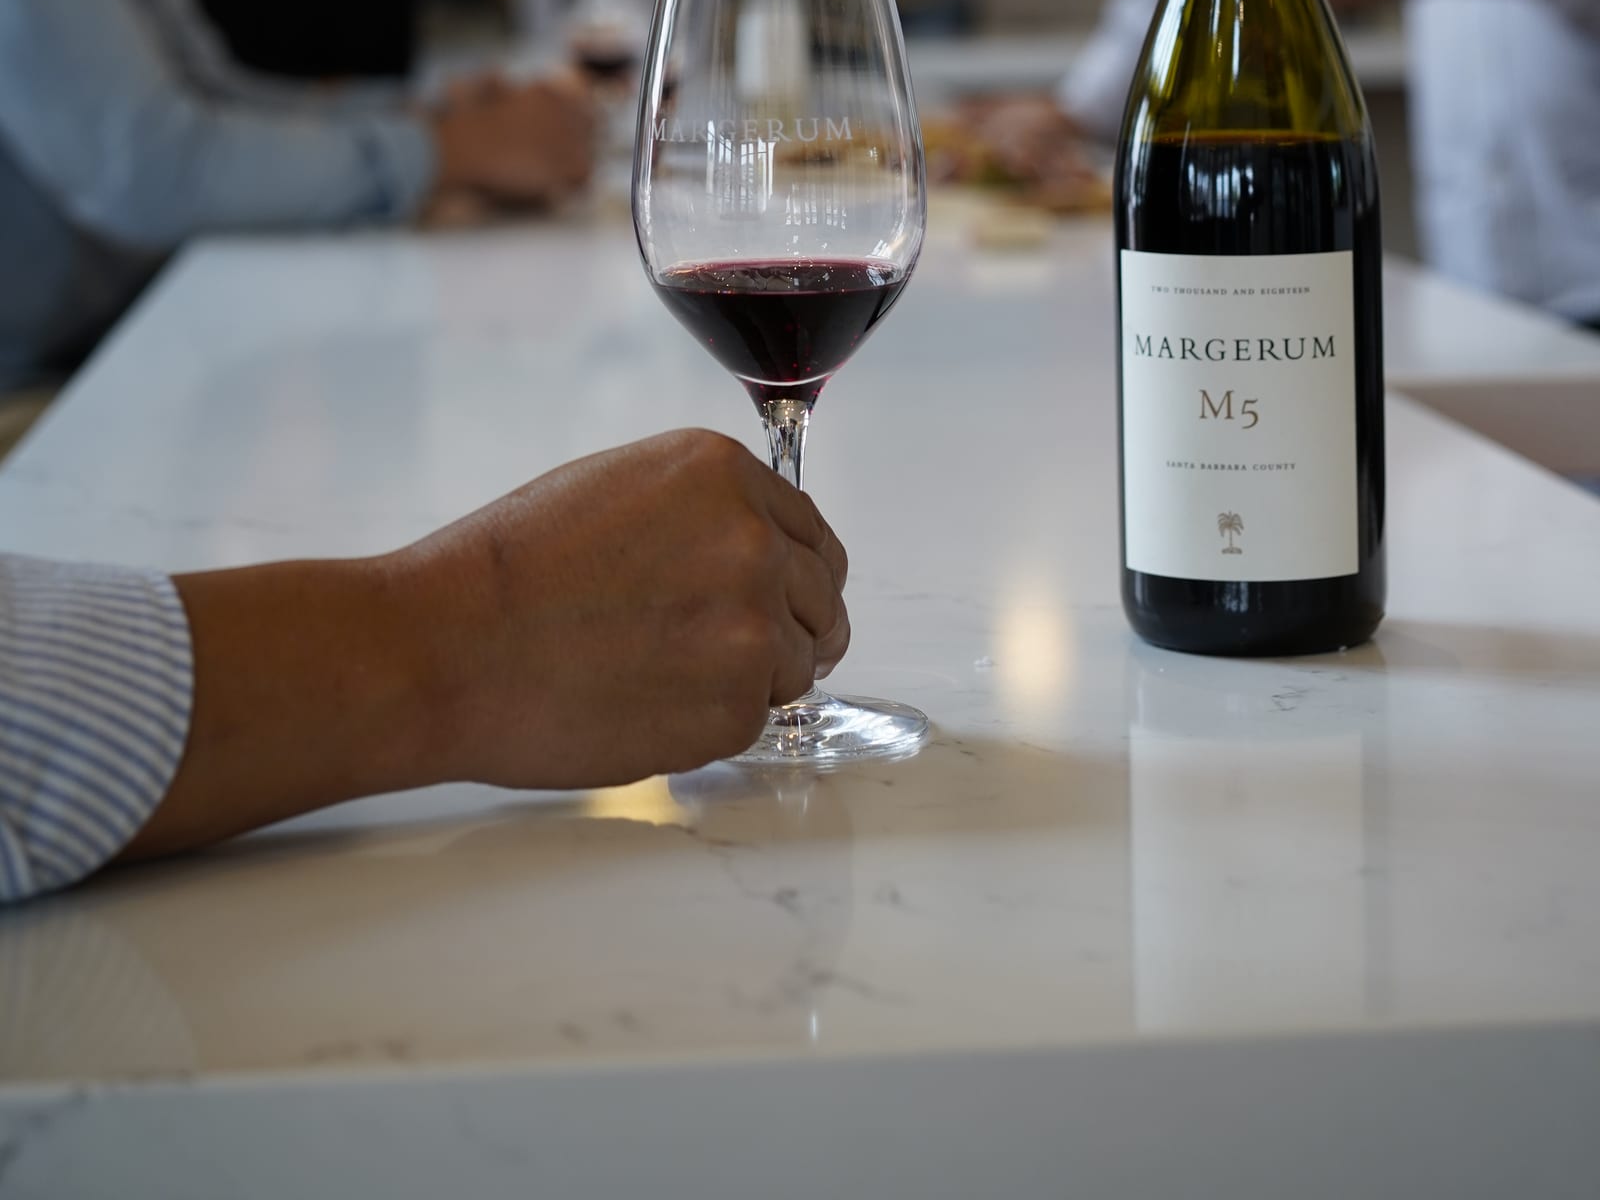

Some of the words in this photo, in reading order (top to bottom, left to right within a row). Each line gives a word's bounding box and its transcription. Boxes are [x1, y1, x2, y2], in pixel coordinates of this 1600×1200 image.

[651, 117, 853, 143] MARGERUM
[1151, 285, 1170, 294] TWO
[1173, 287, 1228, 296] THOUSAND
[1232, 288, 1256, 296] AND
[1260, 286, 1311, 296] EIGHTEEN
[1134, 334, 1337, 361] MARGERUM
[1199, 389, 1259, 430] M5
[1166, 460, 1196, 470] SANTA
[1200, 463, 1248, 471] BARBARA
[1252, 462, 1297, 471] COUNTY
